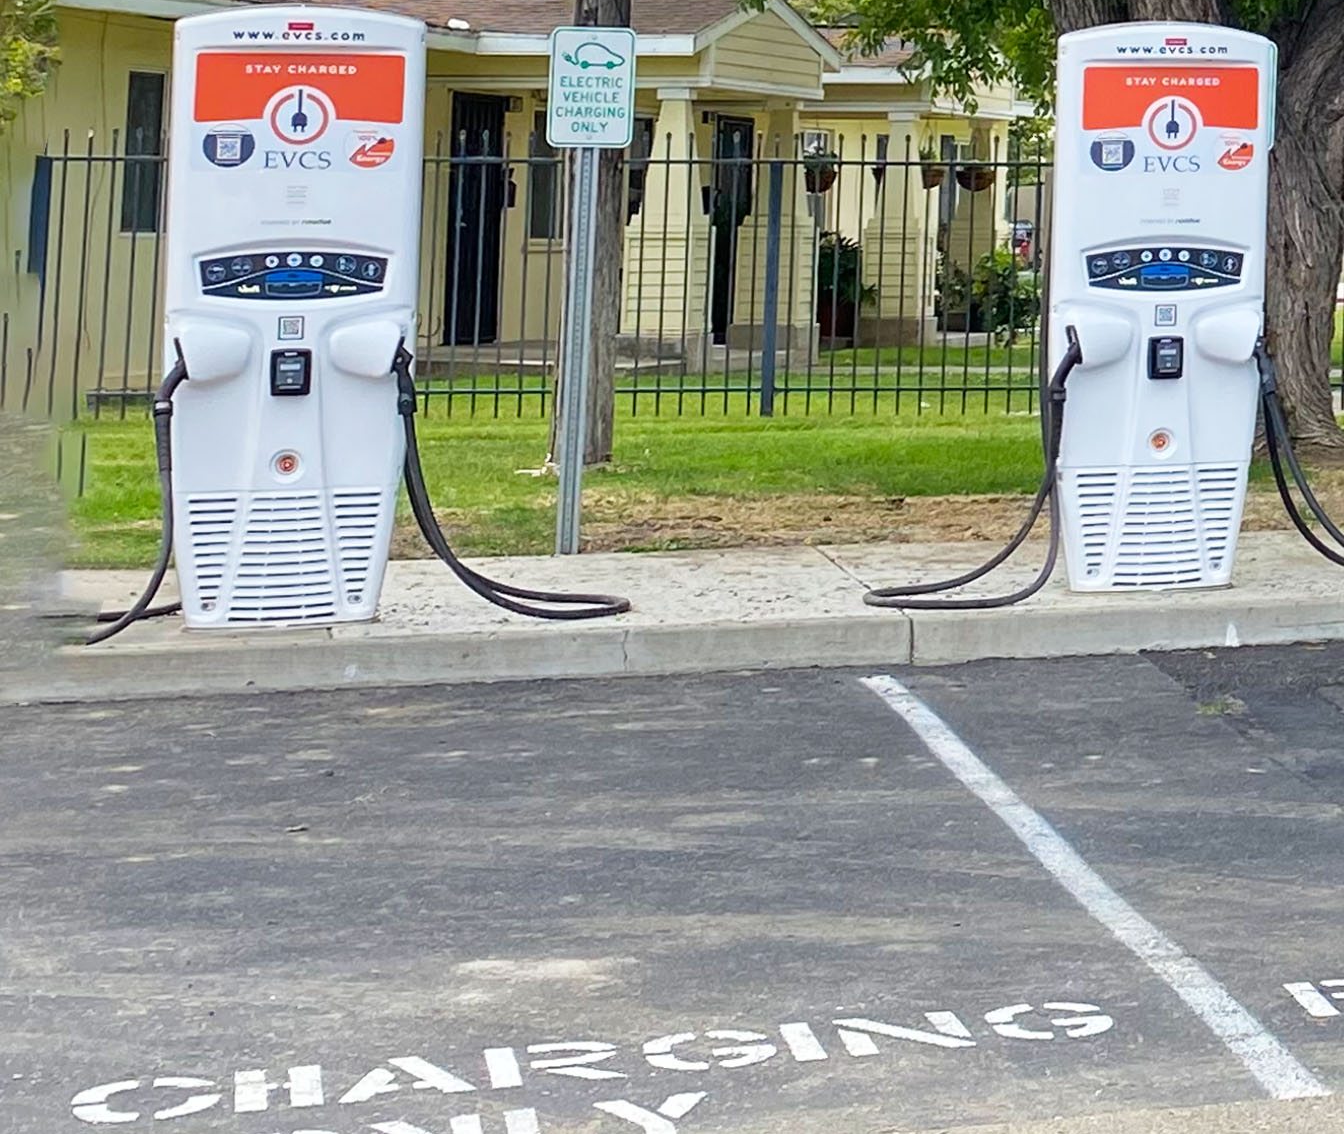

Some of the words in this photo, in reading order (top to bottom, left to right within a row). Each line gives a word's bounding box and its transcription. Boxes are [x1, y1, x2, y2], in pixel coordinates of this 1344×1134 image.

[233, 30, 366, 42] www.evcs.com
[245, 64, 282, 75] STAY
[287, 64, 358, 76] CHARGED
[560, 75, 624, 89] ELECTRIC
[1125, 77, 1157, 86] STAY
[1161, 77, 1221, 87] CHARGED
[562, 91, 620, 104] VEHICLE
[555, 106, 625, 119] CHARGING
[570, 121, 608, 133] ONLY
[263, 149, 332, 171] EVCS
[1142, 155, 1201, 173] EVCS
[70, 1002, 1114, 1124] CHARGING
